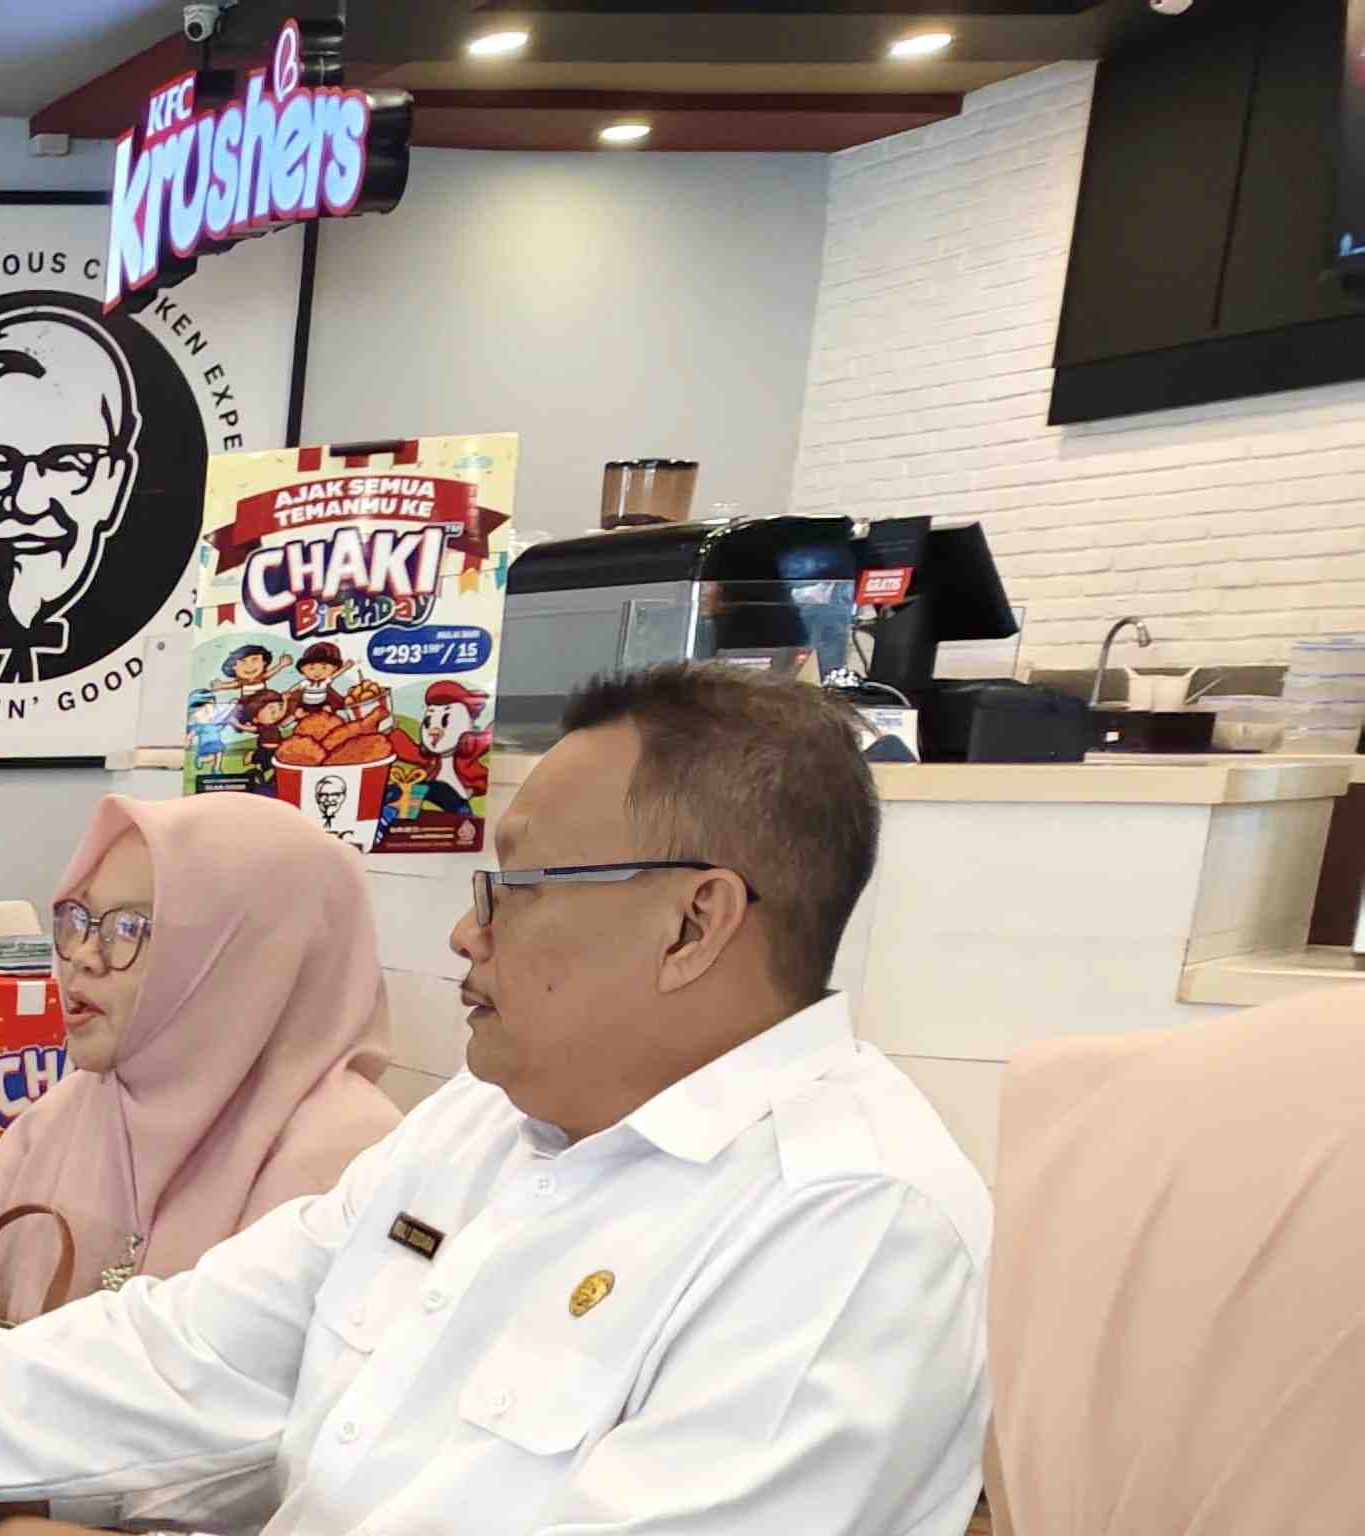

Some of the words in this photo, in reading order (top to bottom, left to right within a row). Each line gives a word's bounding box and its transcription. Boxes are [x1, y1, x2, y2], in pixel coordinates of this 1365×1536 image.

[146, 78, 195, 137] KFC
[105, 74, 366, 304] krushers
[84, 258, 208, 357] CKEN
[203, 364, 244, 451] EXPE
[273, 497, 400, 527] TEMANMU
[398, 501, 435, 518] KE
[274, 479, 343, 509] AJAK
[348, 478, 436, 498] SEMUA
[246, 526, 445, 613] CHAKI
[57, 656, 144, 713] GOOD
